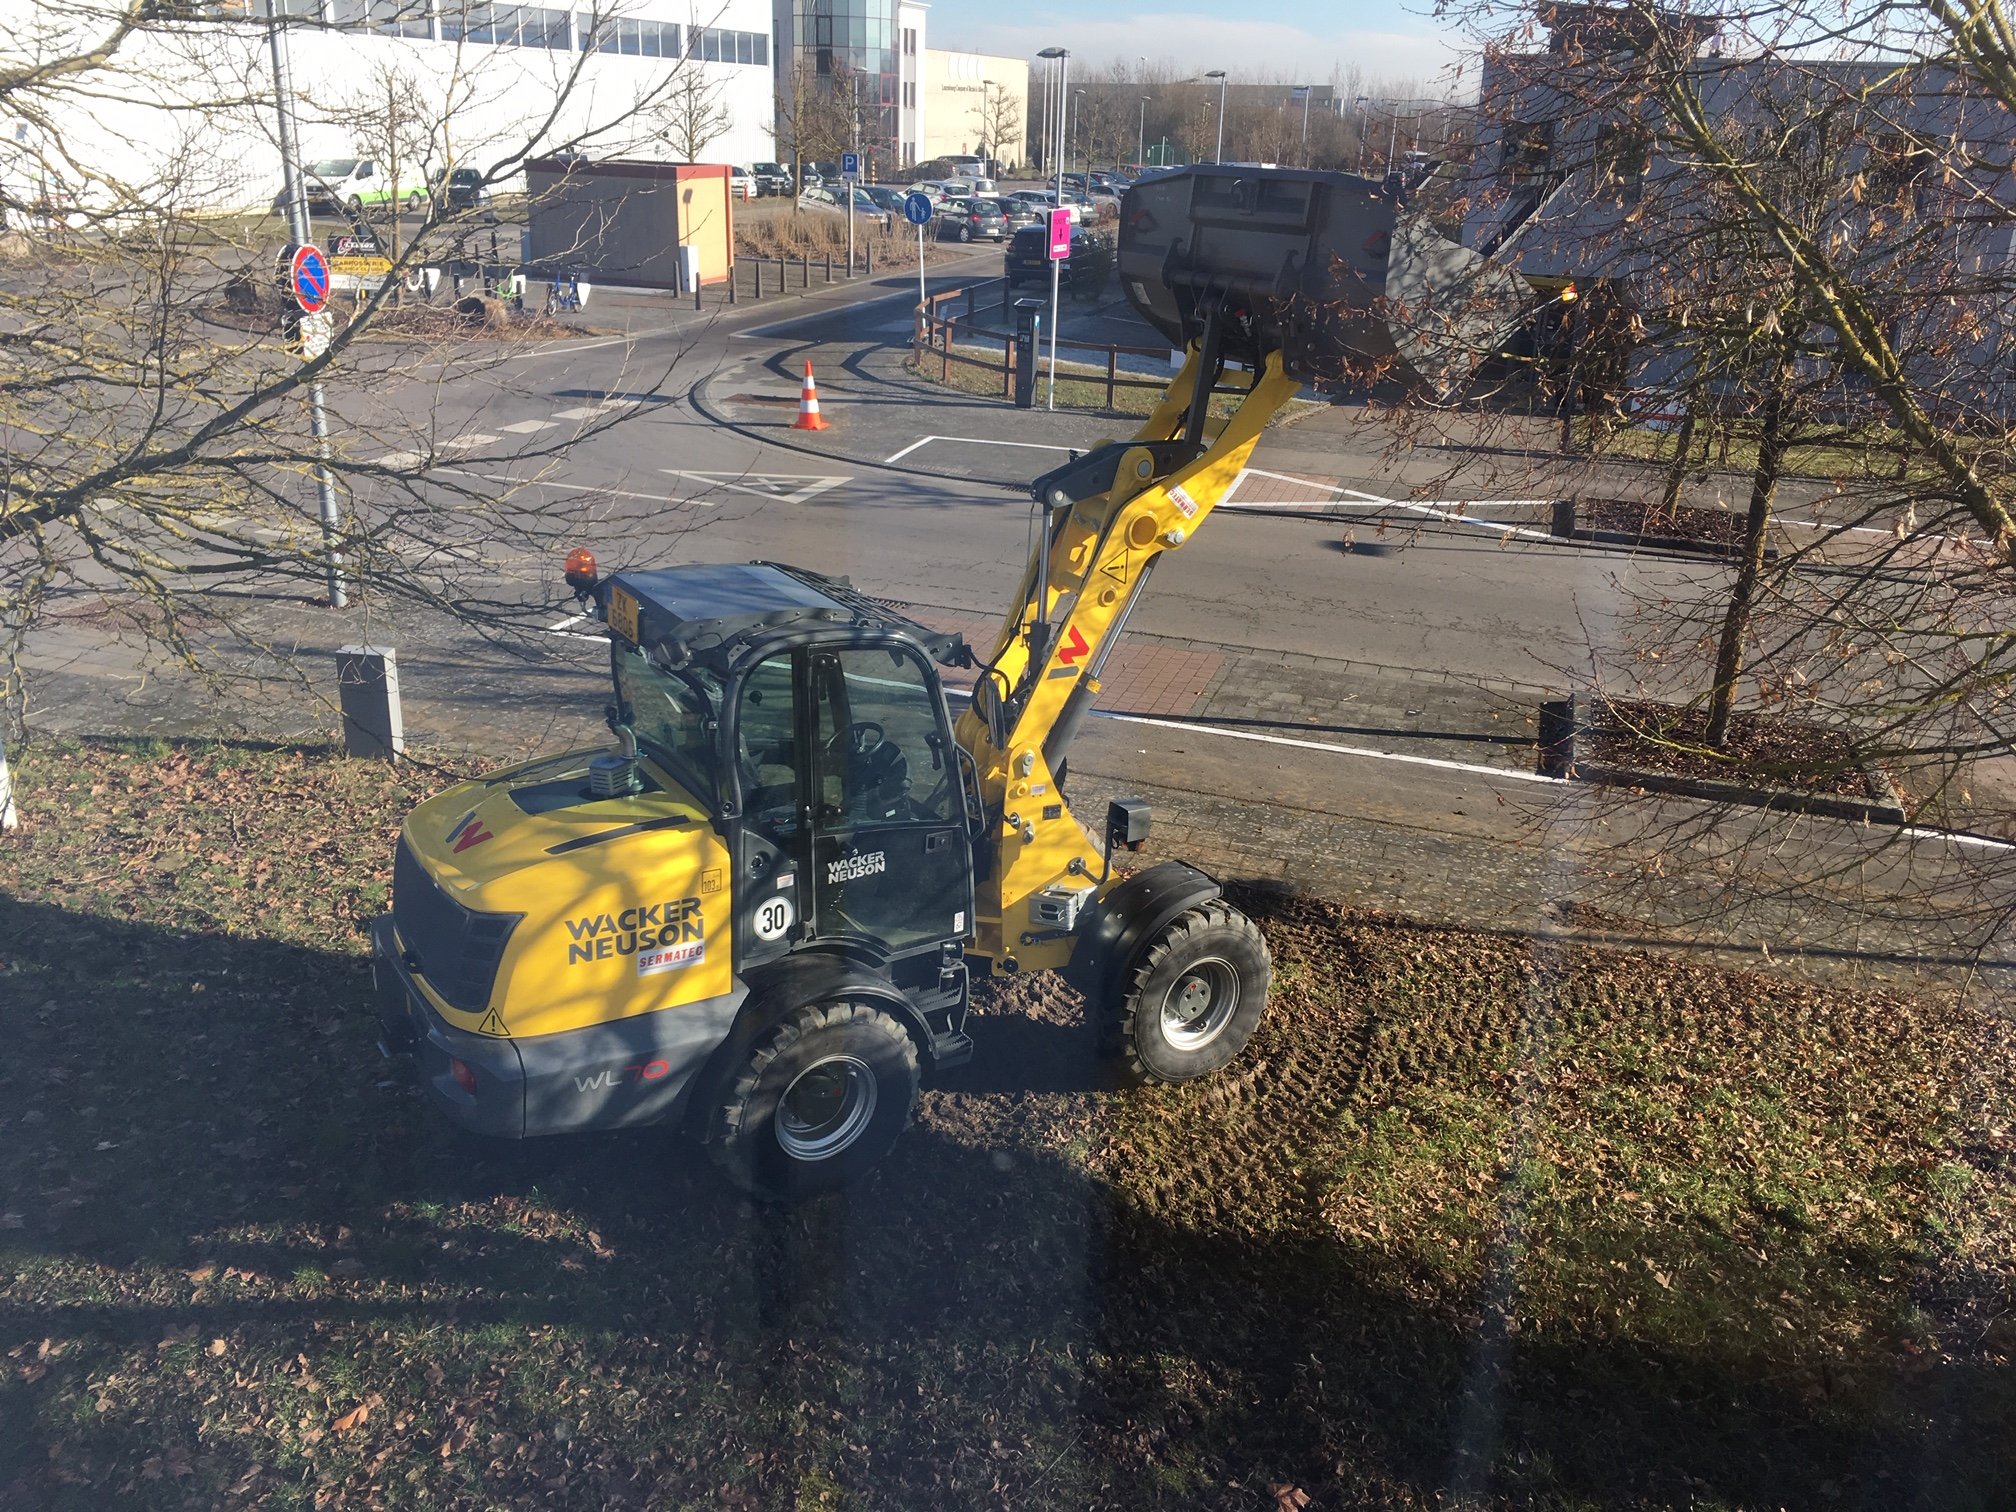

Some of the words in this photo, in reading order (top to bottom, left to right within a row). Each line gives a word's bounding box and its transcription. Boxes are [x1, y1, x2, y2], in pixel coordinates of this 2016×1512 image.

[828, 851, 885, 873] WACKER
[828, 861, 885, 885] NEUSON
[565, 897, 702, 940] WACKER
[763, 904, 784, 933] 30
[569, 919, 704, 965] NEUSON
[639, 945, 704, 967] SERMATEC
